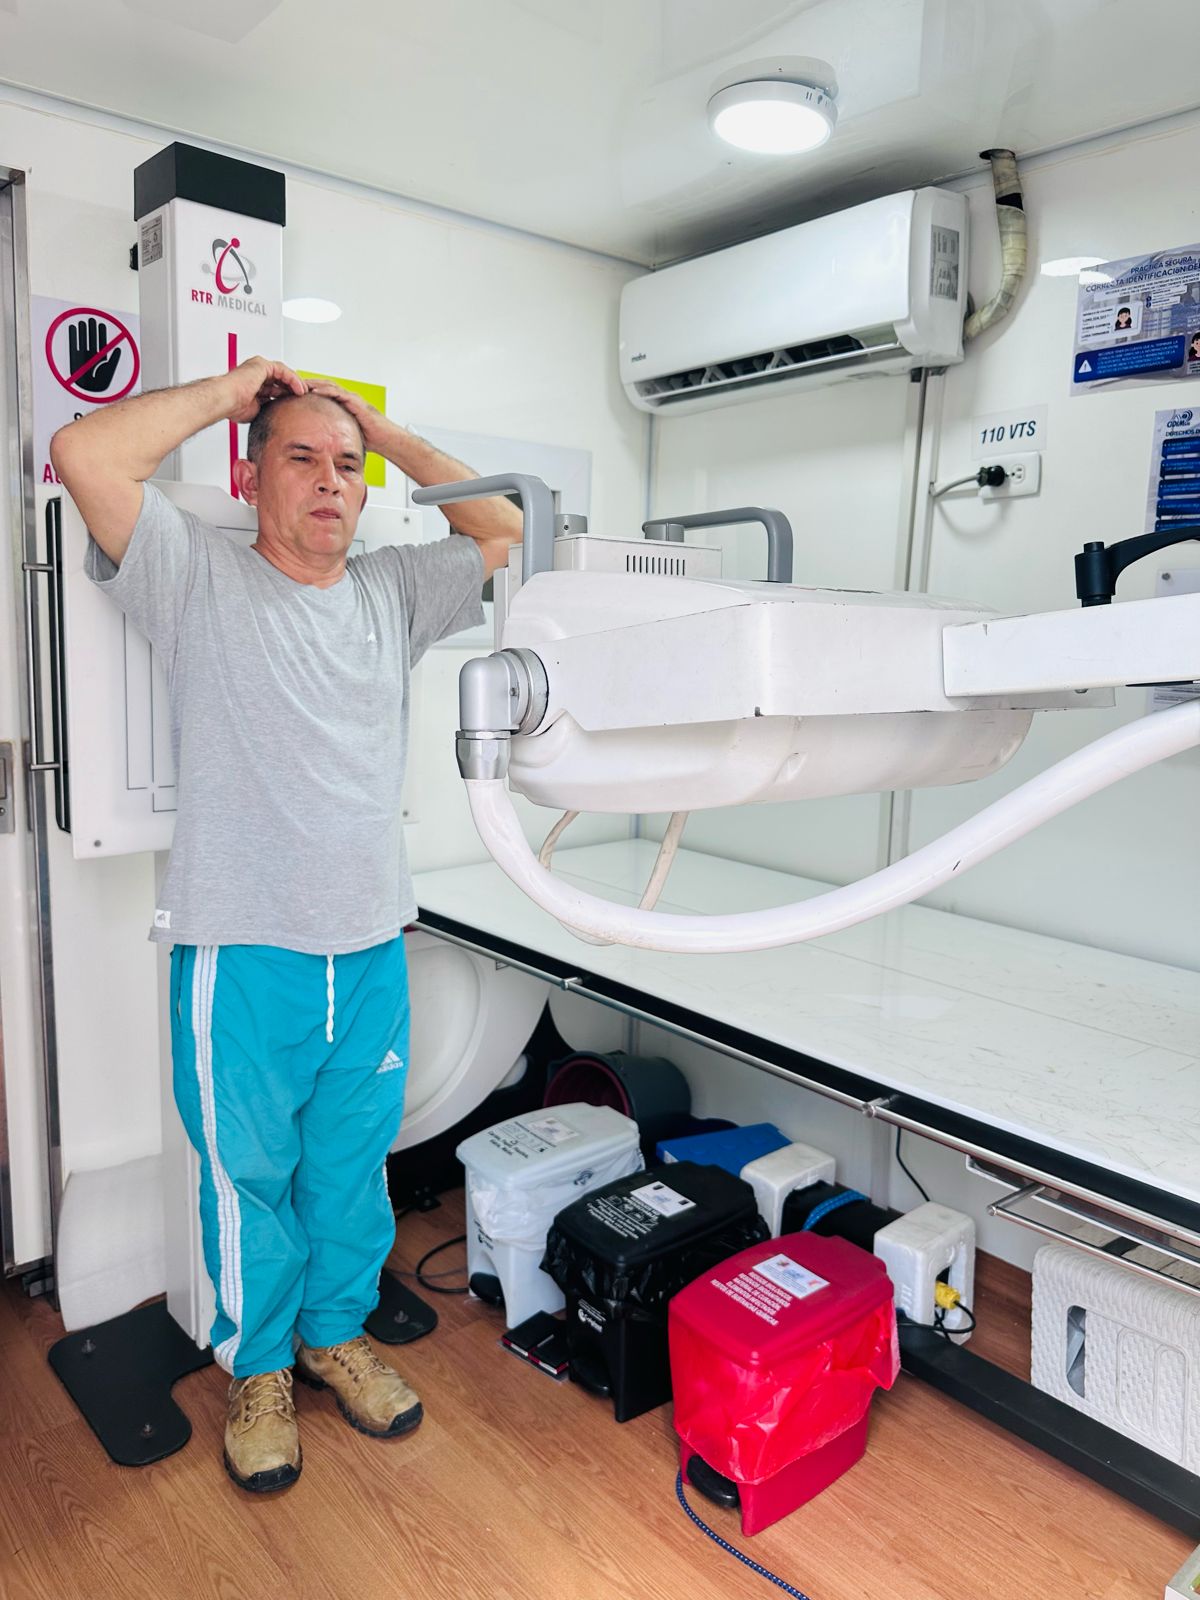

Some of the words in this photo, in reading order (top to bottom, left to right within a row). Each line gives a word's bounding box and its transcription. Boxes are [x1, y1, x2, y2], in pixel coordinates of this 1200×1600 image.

[191, 289, 213, 305] RTR
[217, 295, 267, 316] MEDICAL
[980, 426, 1005, 444] 110
[1009, 420, 1036, 440] VTS
